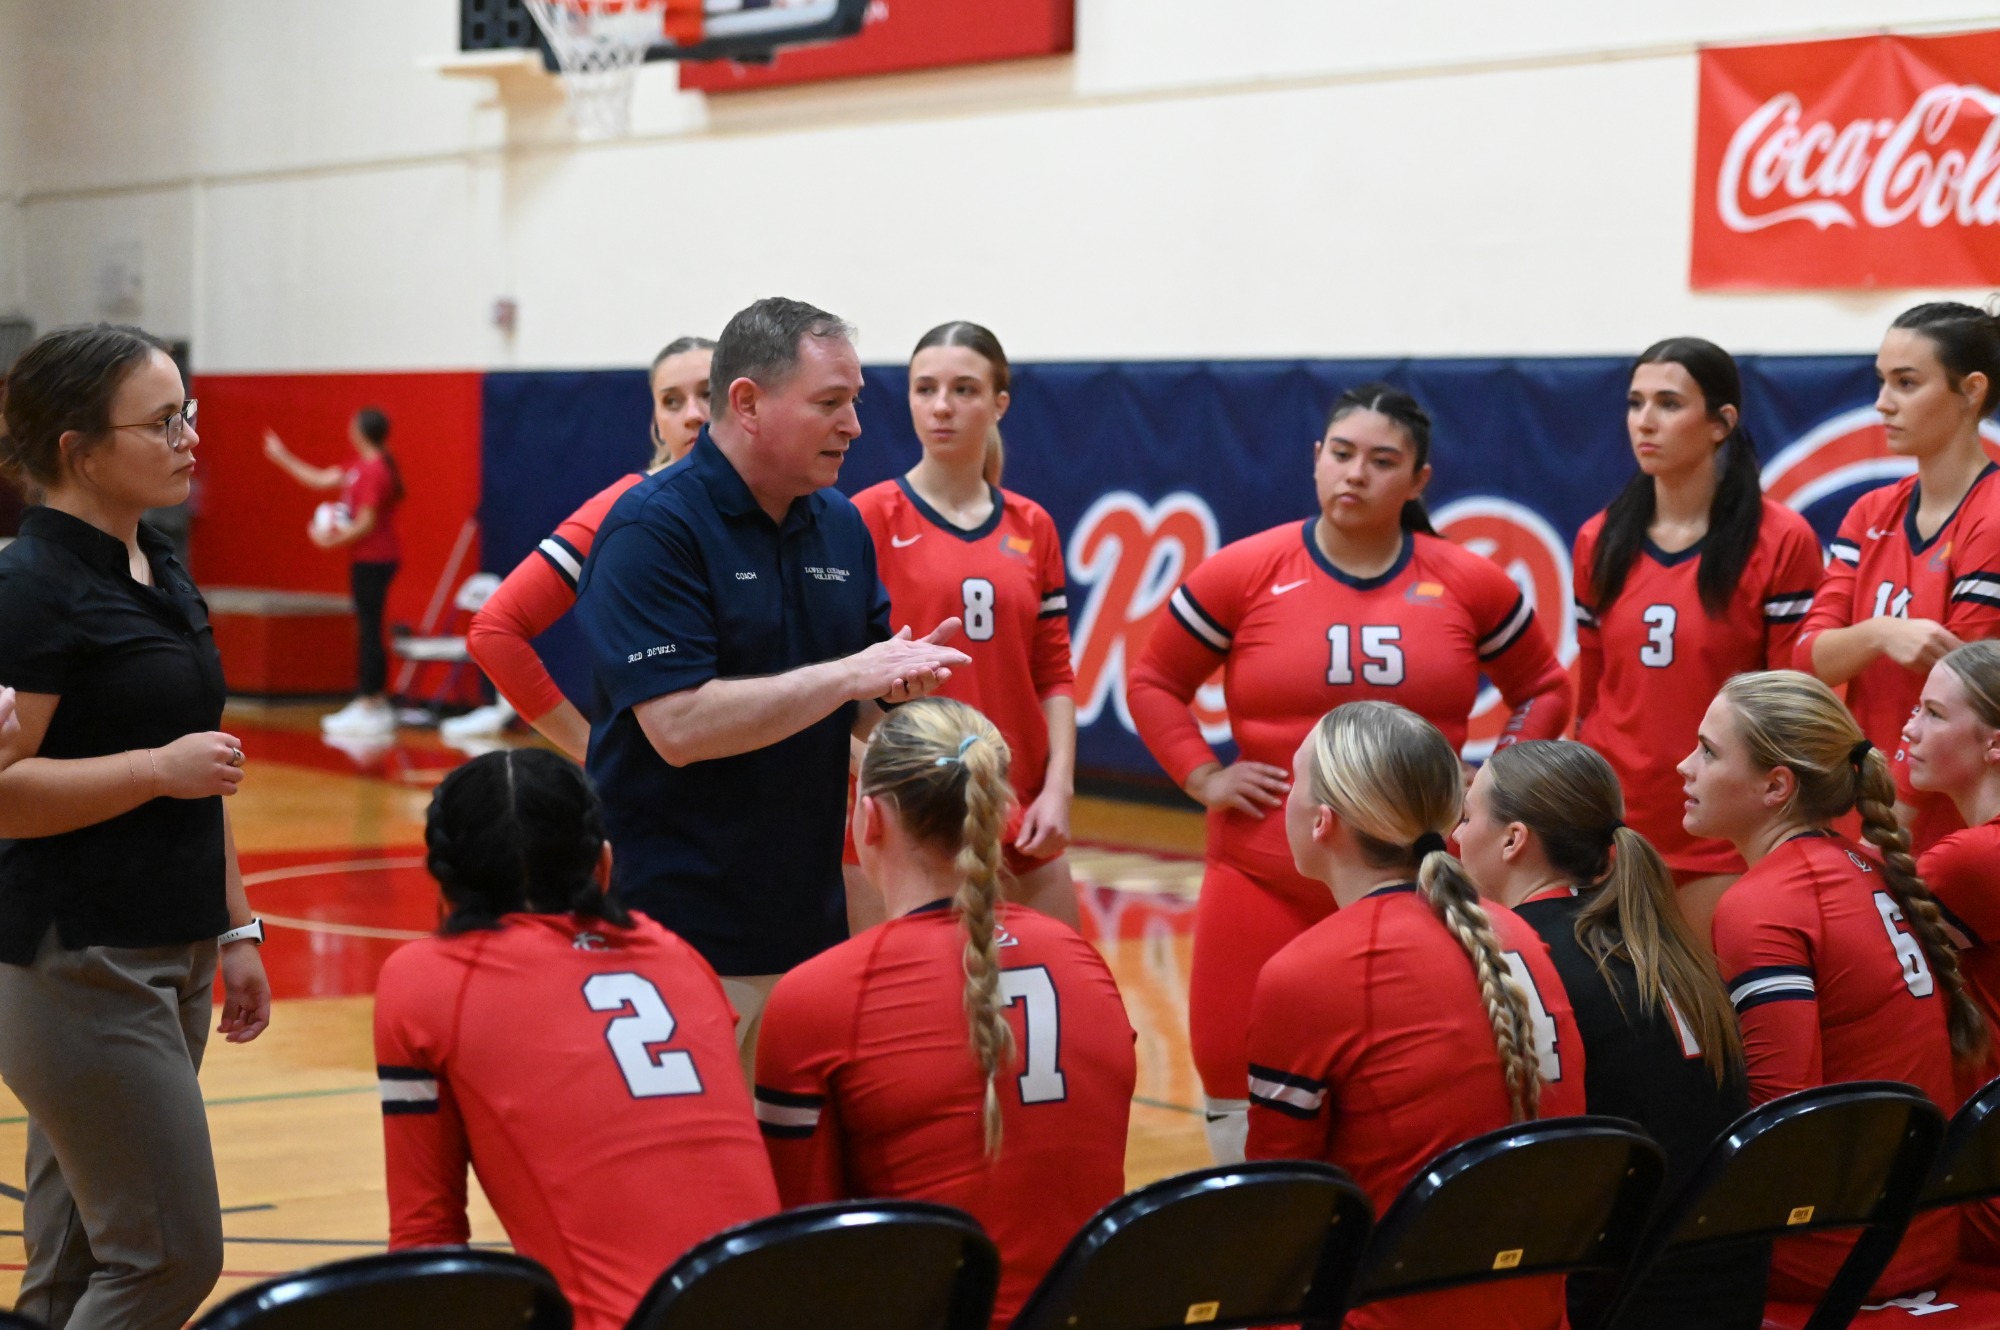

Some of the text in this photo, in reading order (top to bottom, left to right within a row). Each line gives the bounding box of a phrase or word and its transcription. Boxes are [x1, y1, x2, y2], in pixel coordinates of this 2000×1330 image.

[735, 571, 757, 580] COACH
[961, 577, 996, 642] 8
[1639, 603, 1678, 669] 3
[627, 643, 676, 664] RED DEVILS
[1326, 623, 1405, 687] 15
[1872, 889, 1934, 999] 6
[581, 971, 706, 1098] 2
[997, 963, 1067, 1106] 7
